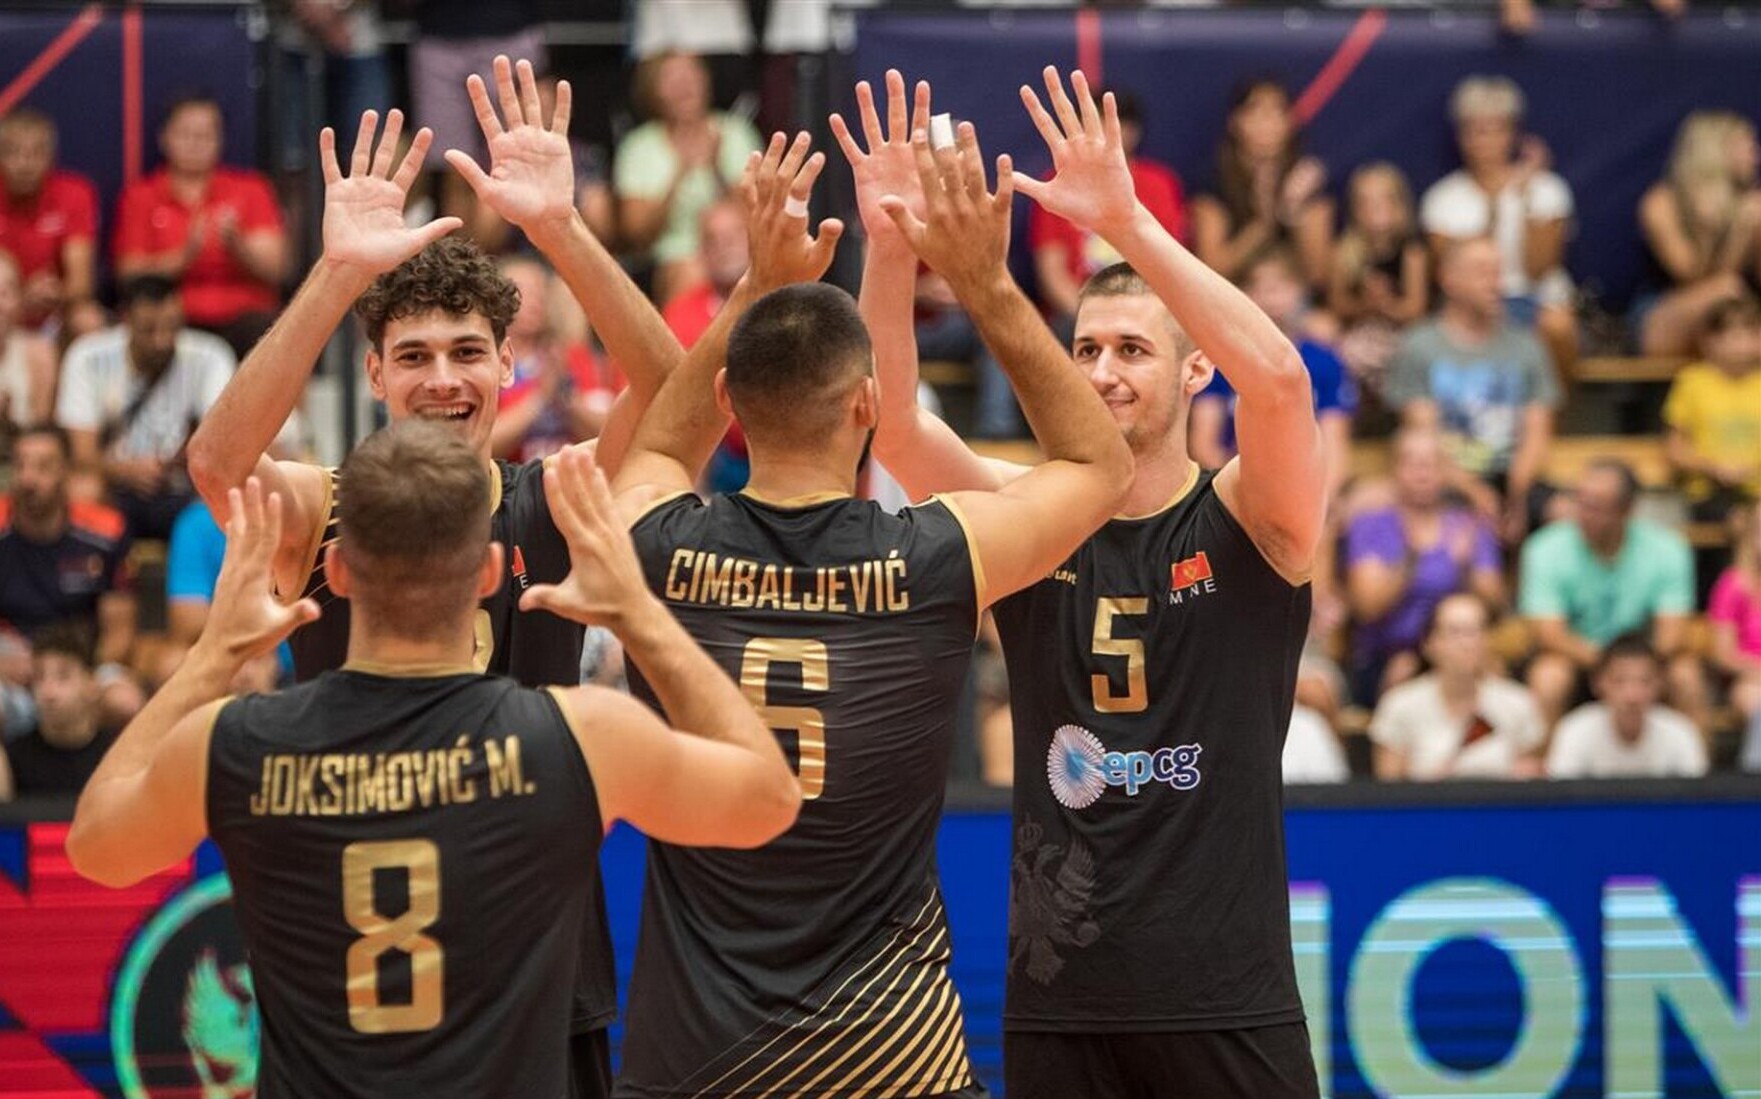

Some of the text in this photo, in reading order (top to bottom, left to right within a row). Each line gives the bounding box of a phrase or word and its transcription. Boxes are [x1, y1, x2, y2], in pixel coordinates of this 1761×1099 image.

[665, 548, 909, 613] CIMBALJEVIĆ
[1169, 578, 1217, 605] MNE
[1091, 597, 1149, 713] 5
[739, 637, 829, 800] 6
[250, 734, 537, 816] JOKSIMOVIĆ M.
[1102, 743, 1203, 796] epcg
[342, 839, 444, 1035] 8
